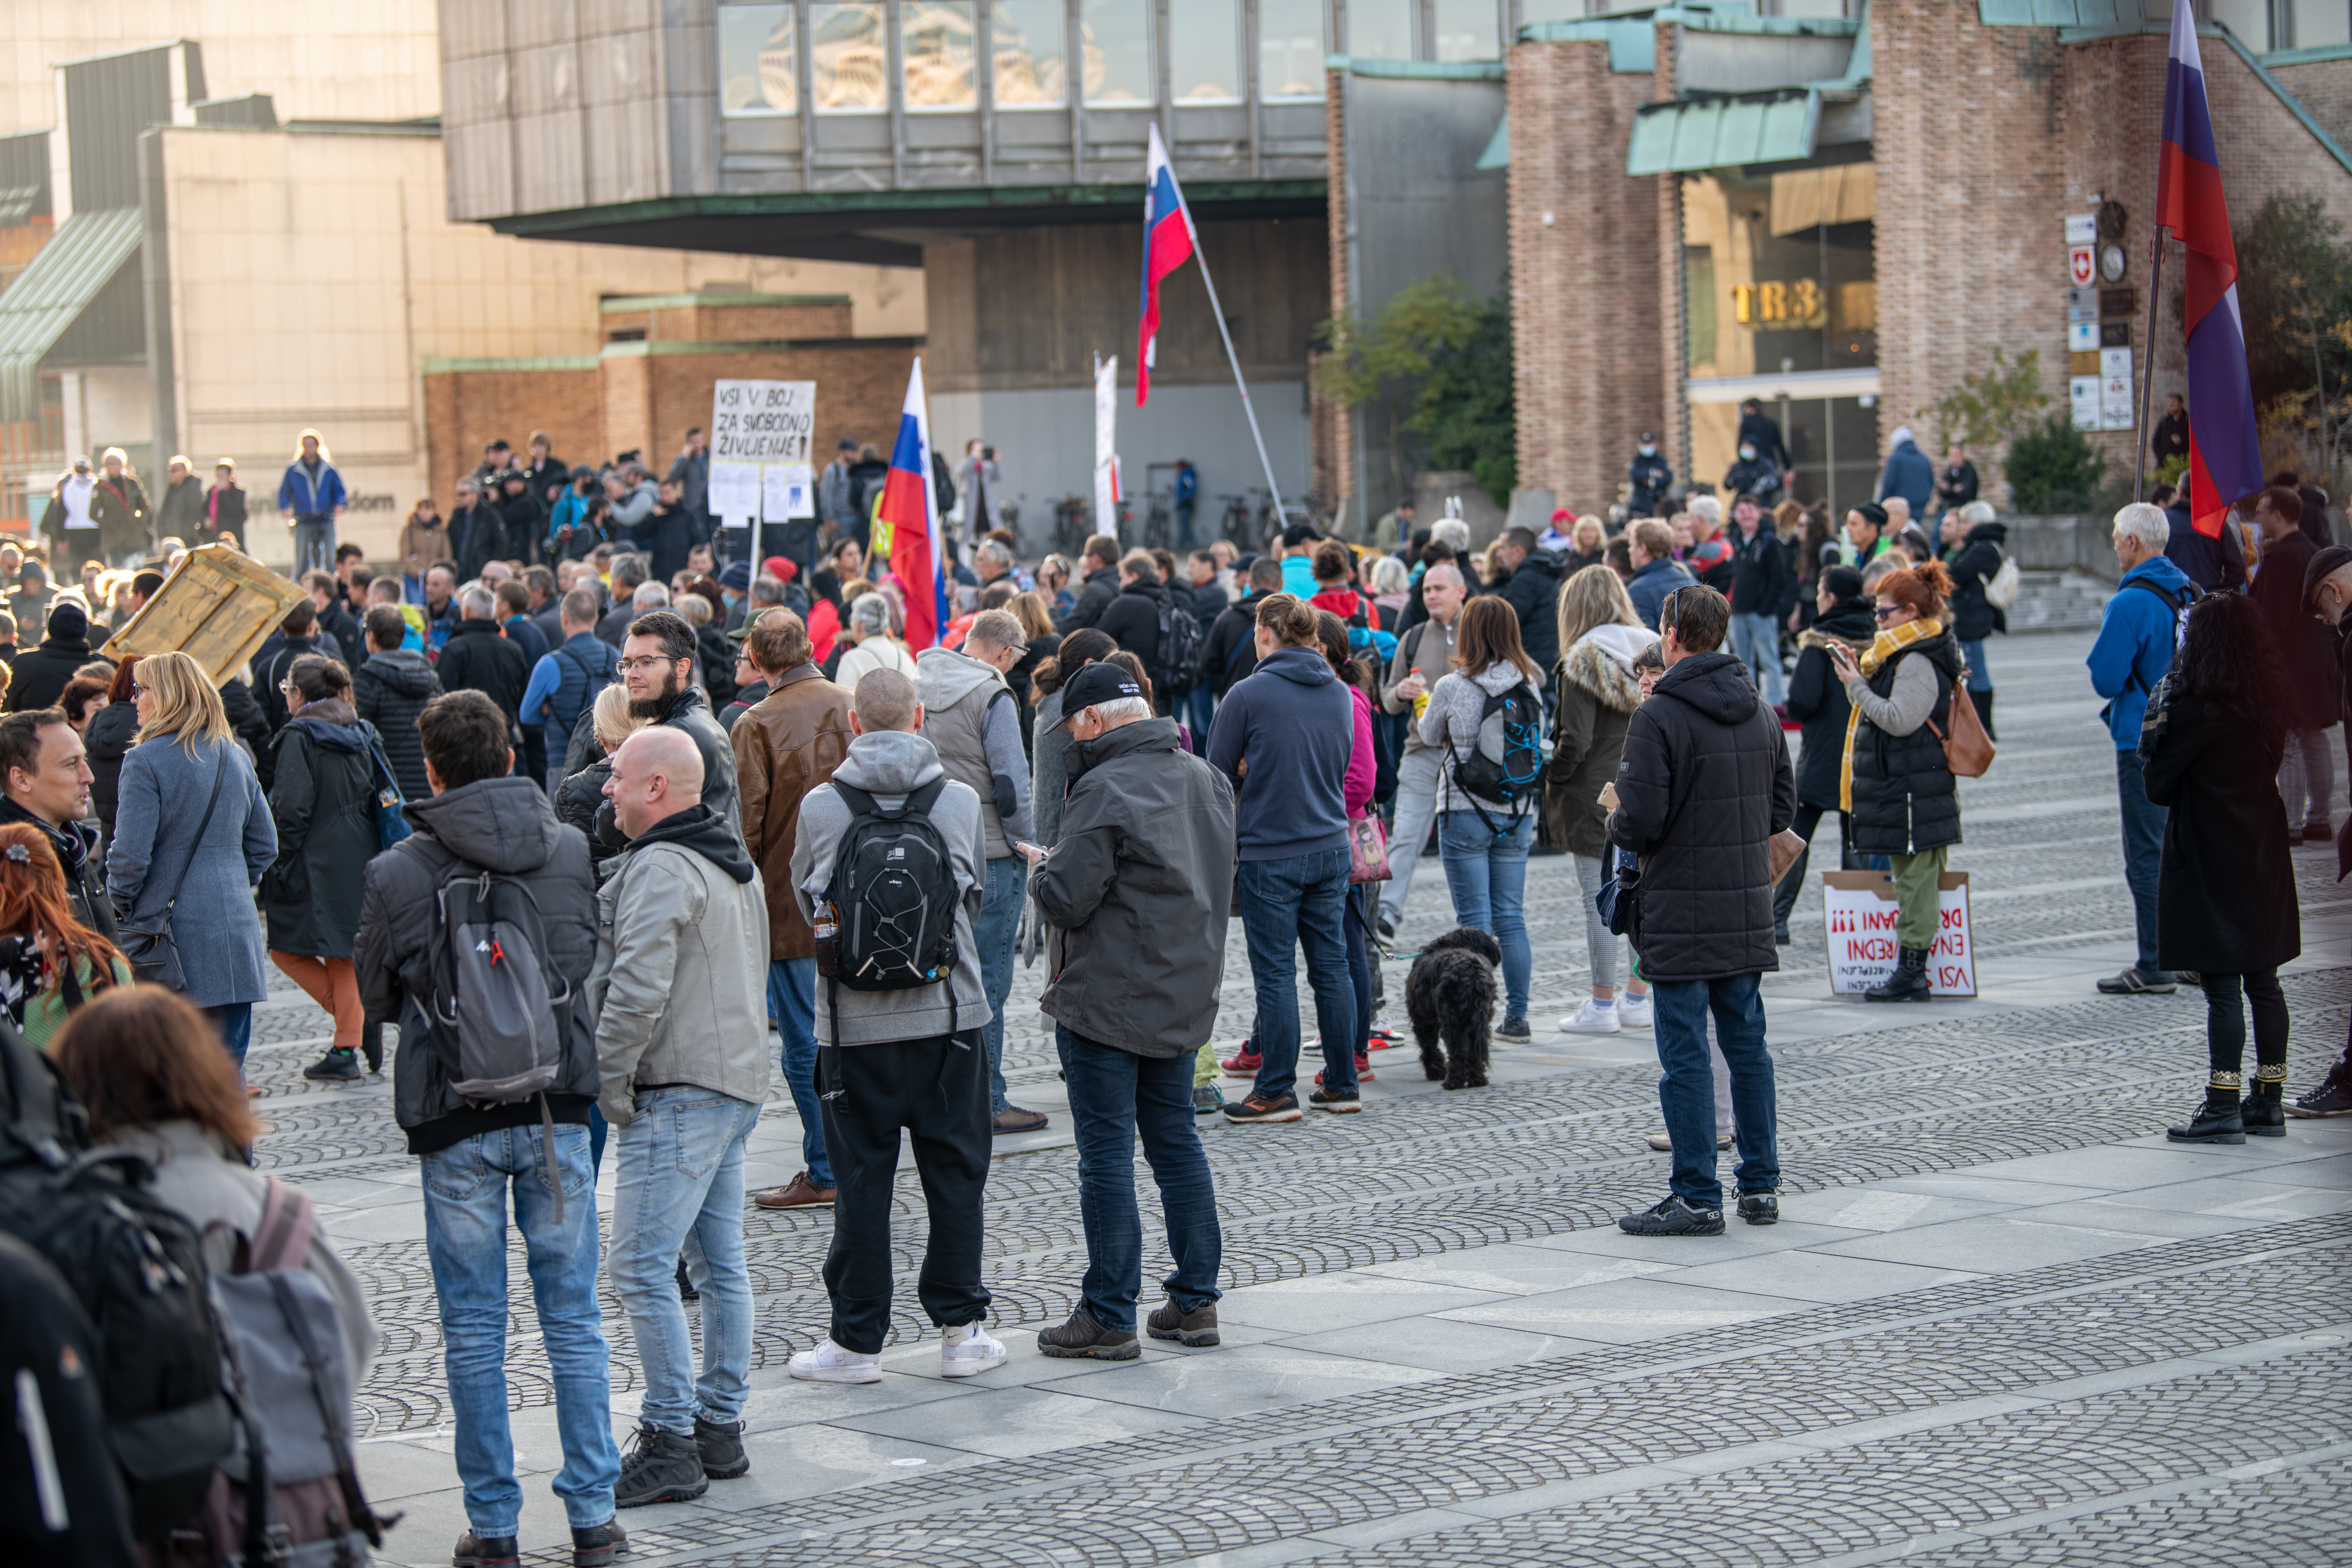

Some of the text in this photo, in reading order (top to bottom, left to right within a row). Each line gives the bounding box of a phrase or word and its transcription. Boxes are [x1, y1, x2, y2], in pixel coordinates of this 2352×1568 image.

[1730, 277, 1818, 324] TR3
[720, 388, 795, 407] VSI V BOJ
[717, 413, 810, 433] ZA SVOBODNO
[1939, 966, 1970, 988] VSI
